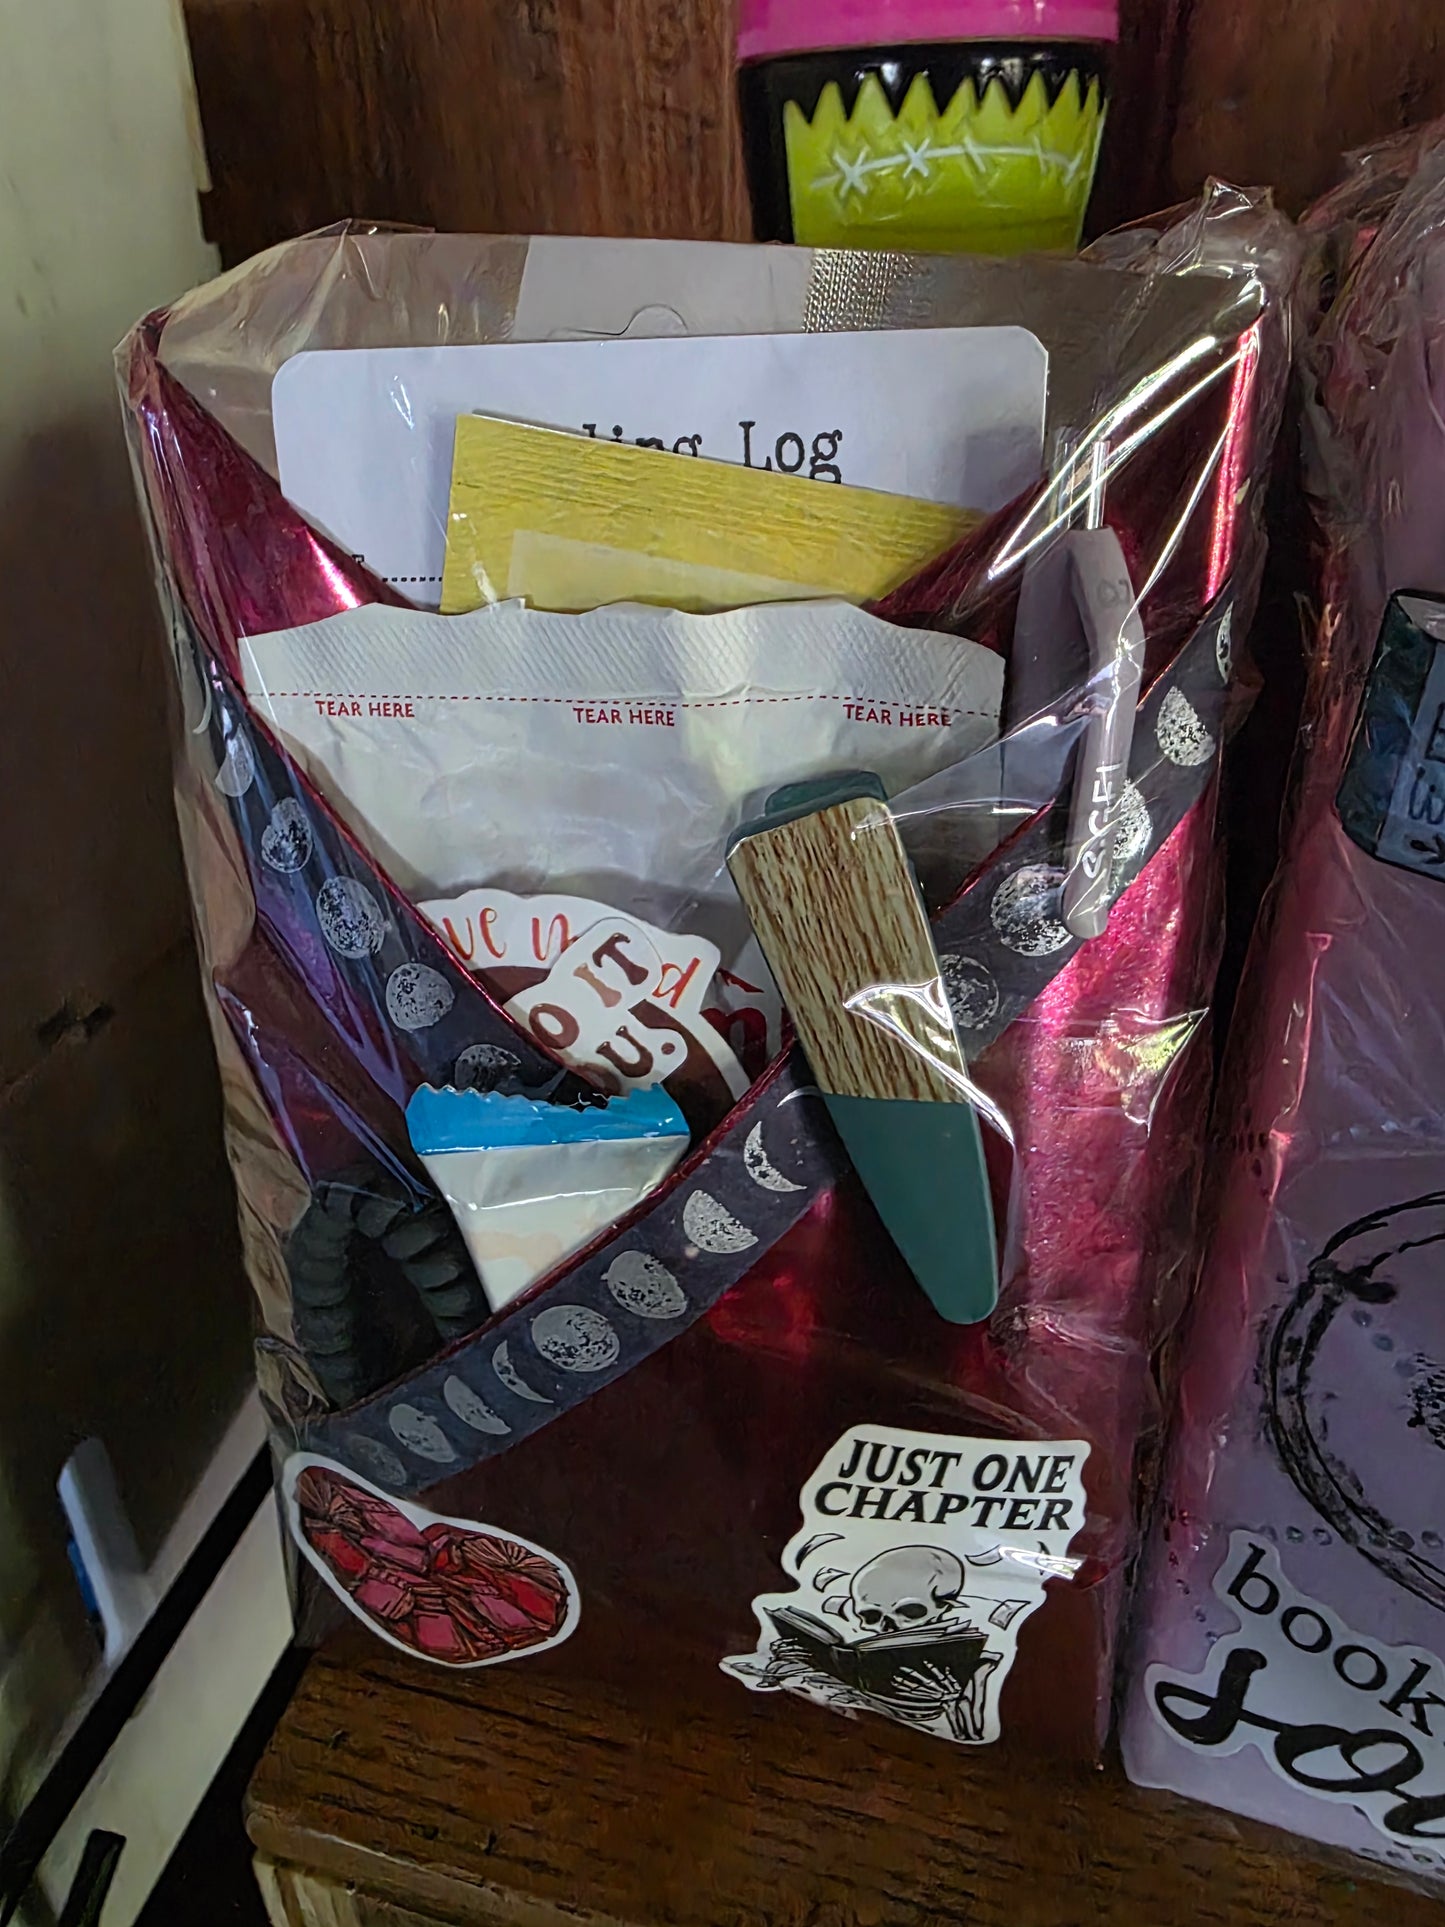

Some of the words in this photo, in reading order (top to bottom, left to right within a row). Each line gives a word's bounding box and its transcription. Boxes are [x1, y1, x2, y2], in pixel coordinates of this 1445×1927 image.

[739, 421, 843, 484] Log
[315, 700, 362, 717] TEAR
[369, 702, 416, 718] HERE
[573, 707, 623, 724] TEAR
[629, 709, 675, 727] HERE
[842, 704, 892, 725] TEAR
[899, 711, 952, 727] HERE
[573, 932, 649, 1008] IT
[838, 1438, 963, 1488] JUST
[973, 1453, 1075, 1494] ONE
[814, 1481, 1075, 1531] CHAPTER
[1228, 1541, 1445, 1737] book
